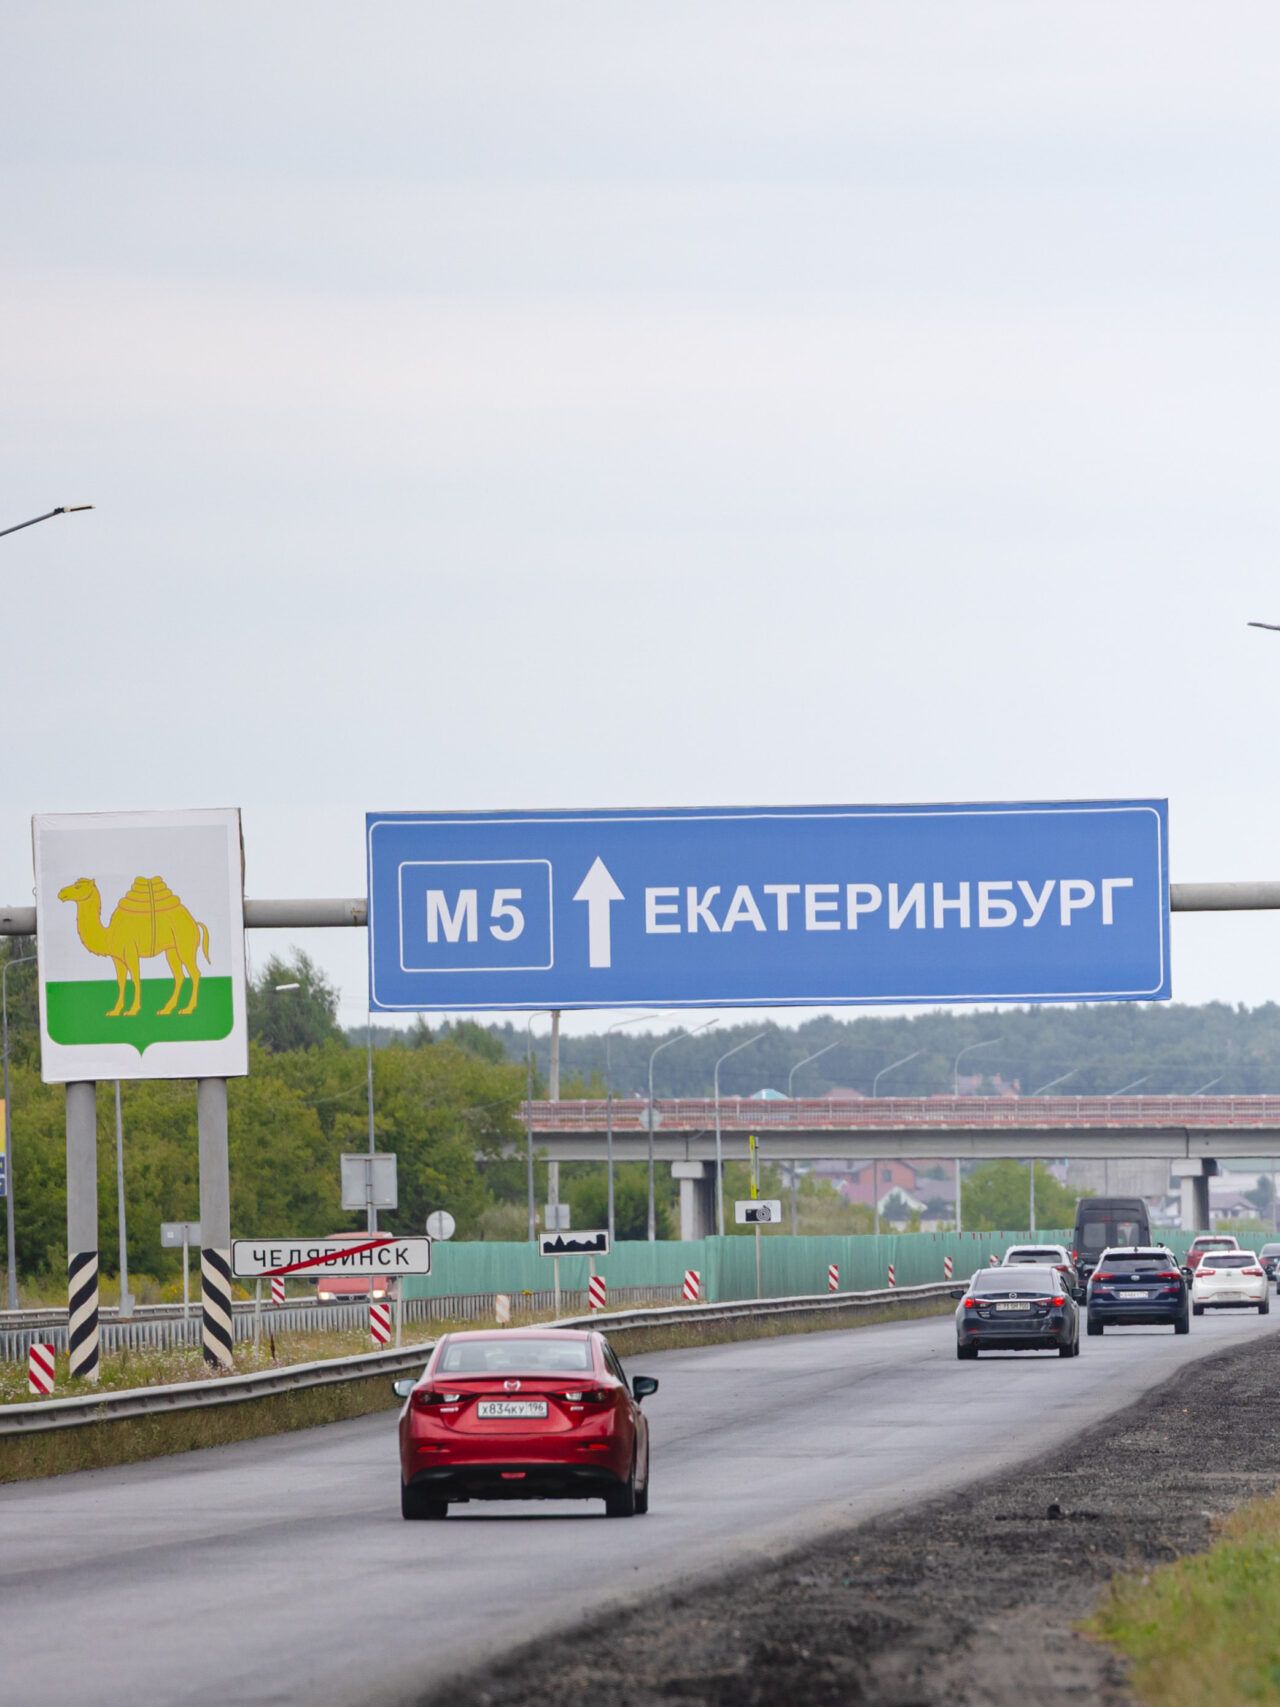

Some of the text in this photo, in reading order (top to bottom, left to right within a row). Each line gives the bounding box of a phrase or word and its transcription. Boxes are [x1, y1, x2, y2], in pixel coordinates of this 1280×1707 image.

[426, 888, 525, 943] М5
[644, 877, 1134, 934] ЕКАТЕРИНБУРГ
[253, 1247, 410, 1268] ЧЕЛЯБИНСК
